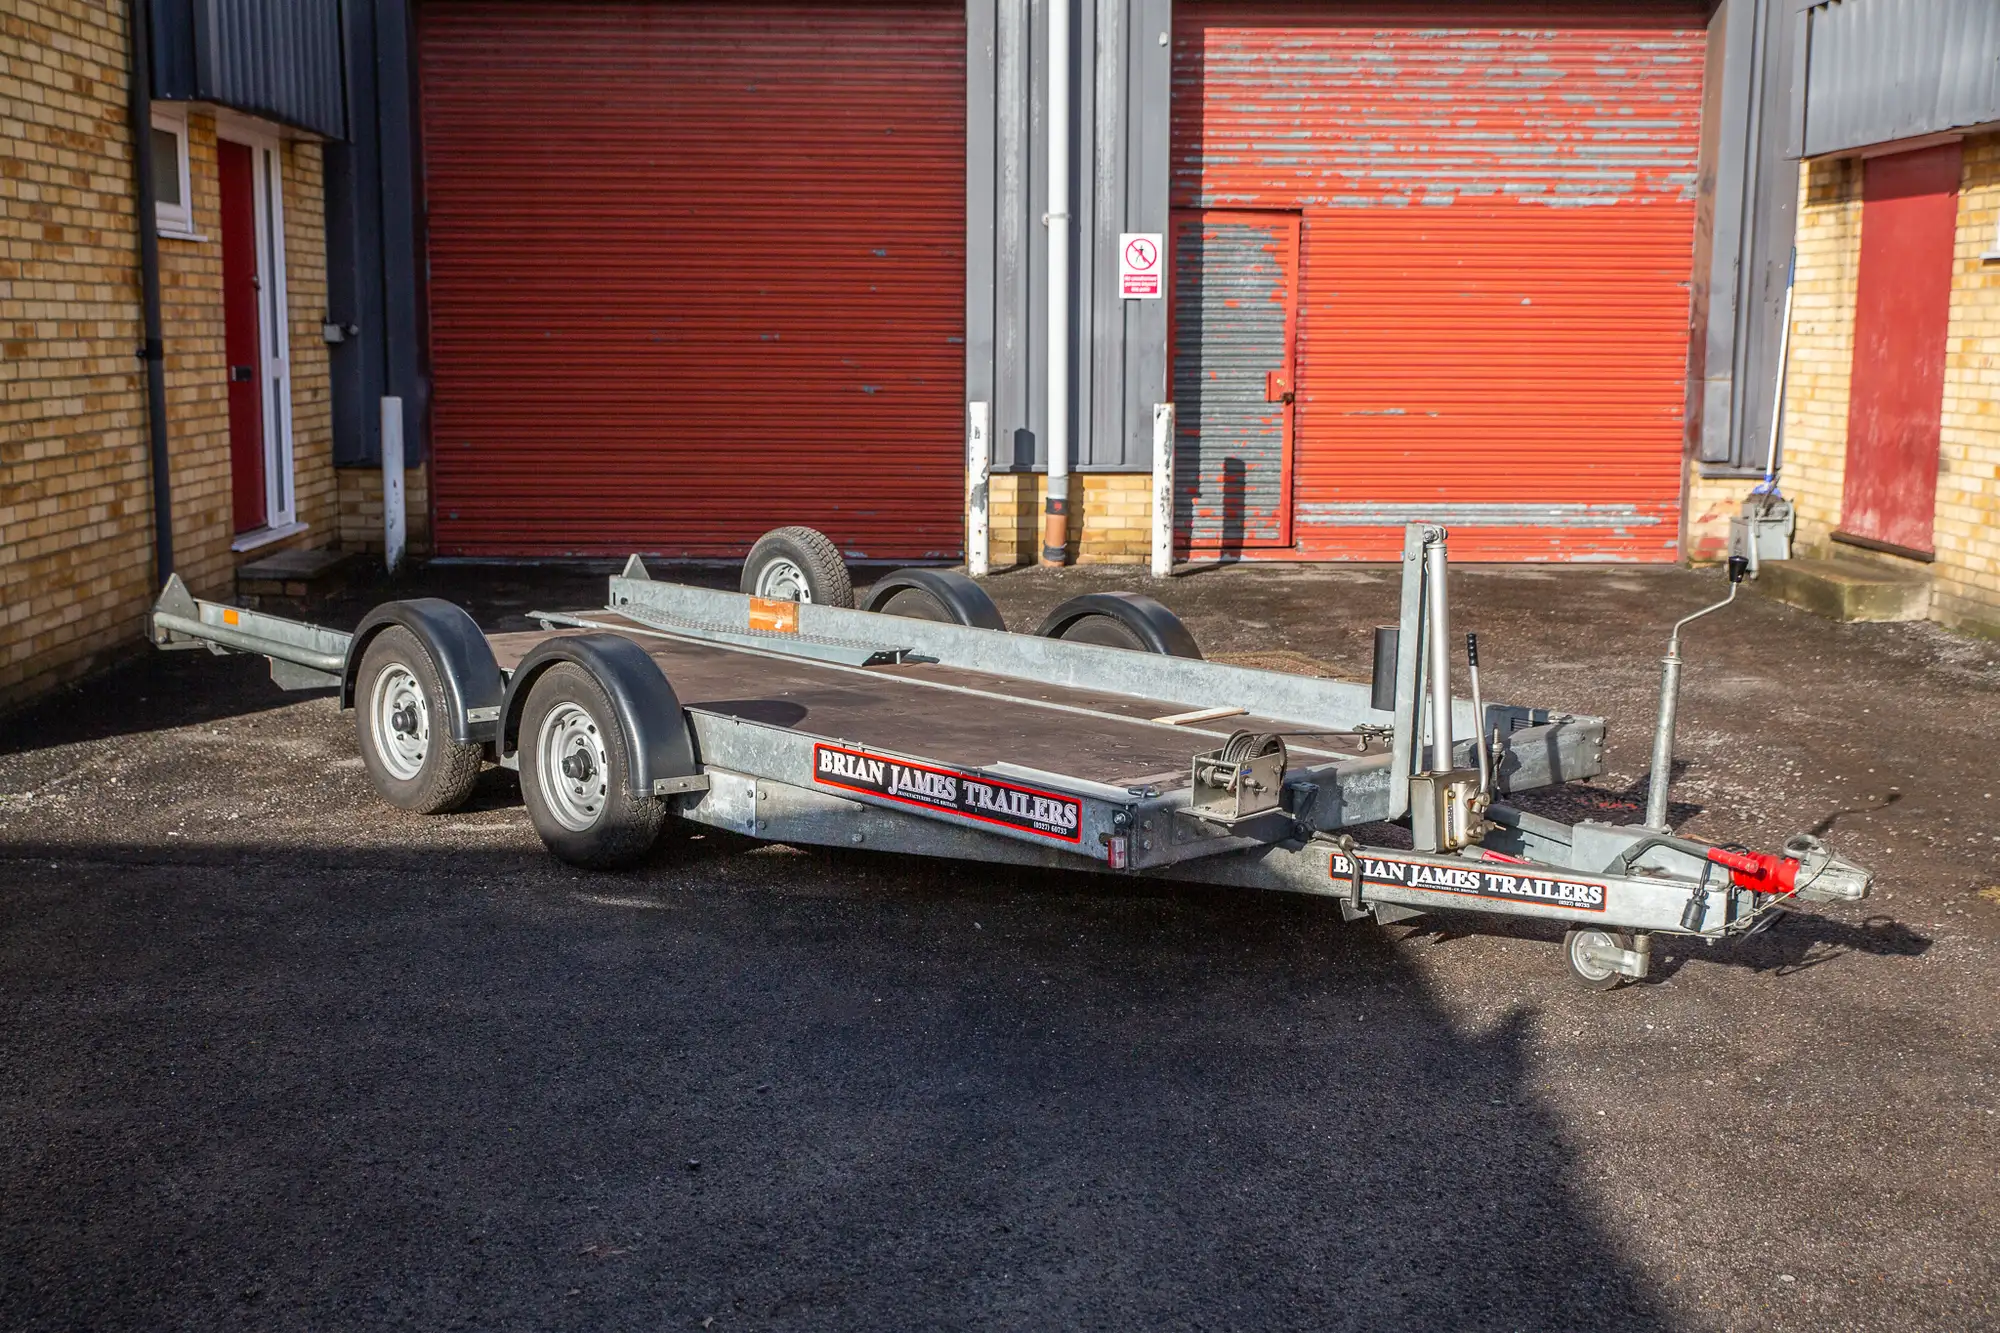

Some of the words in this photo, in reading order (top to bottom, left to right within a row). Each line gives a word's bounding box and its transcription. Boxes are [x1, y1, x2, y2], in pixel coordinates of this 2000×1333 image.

[819, 749, 884, 786] BRIAN
[888, 767, 957, 802] JAMES
[962, 781, 1078, 829] TRAILERS
[1407, 865, 1480, 889] JAMES
[1485, 873, 1603, 904] TRAILERS
